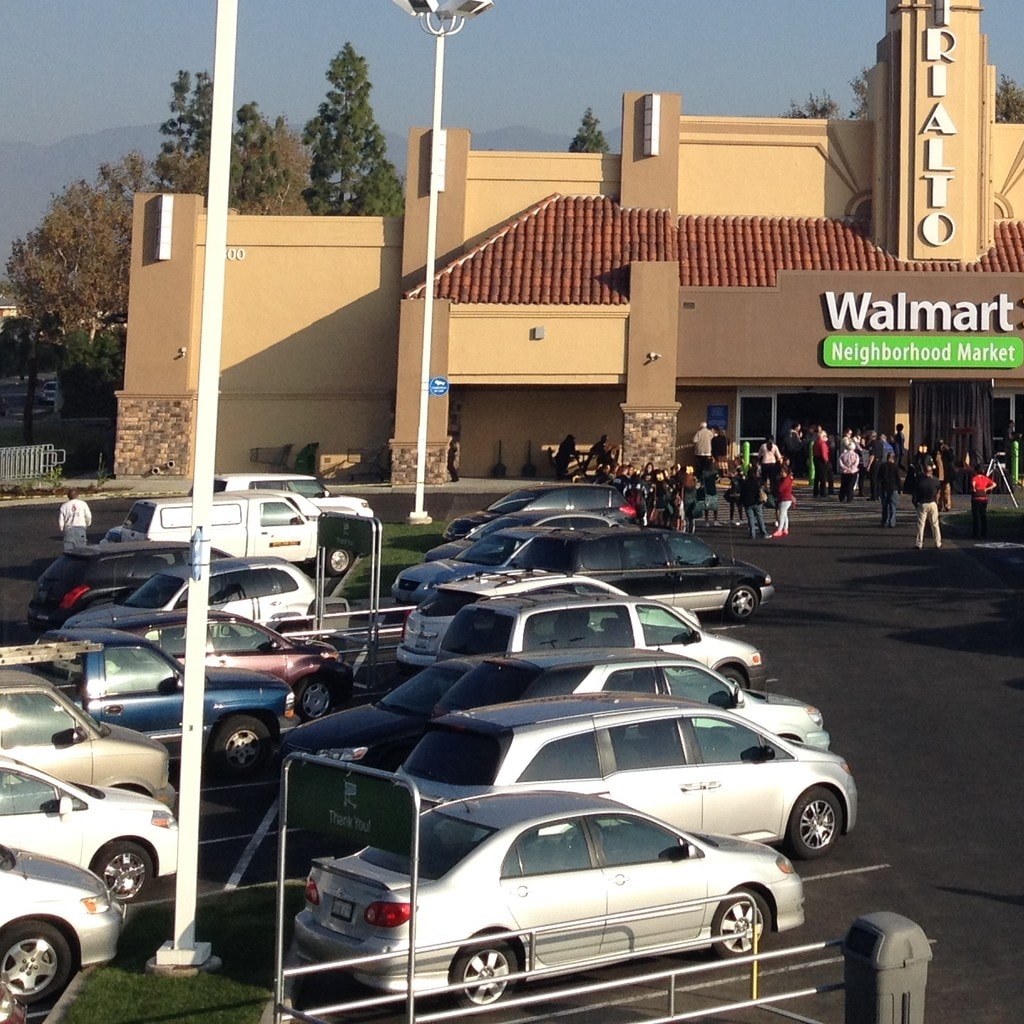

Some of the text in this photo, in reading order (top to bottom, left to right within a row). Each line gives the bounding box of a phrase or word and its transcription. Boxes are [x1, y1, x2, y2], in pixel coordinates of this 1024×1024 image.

[919, 27, 958, 247] RIALTO
[824, 291, 1014, 331] Walmart
[831, 342, 1016, 365] Neighborhood Market
[328, 809, 353, 829] Thank
